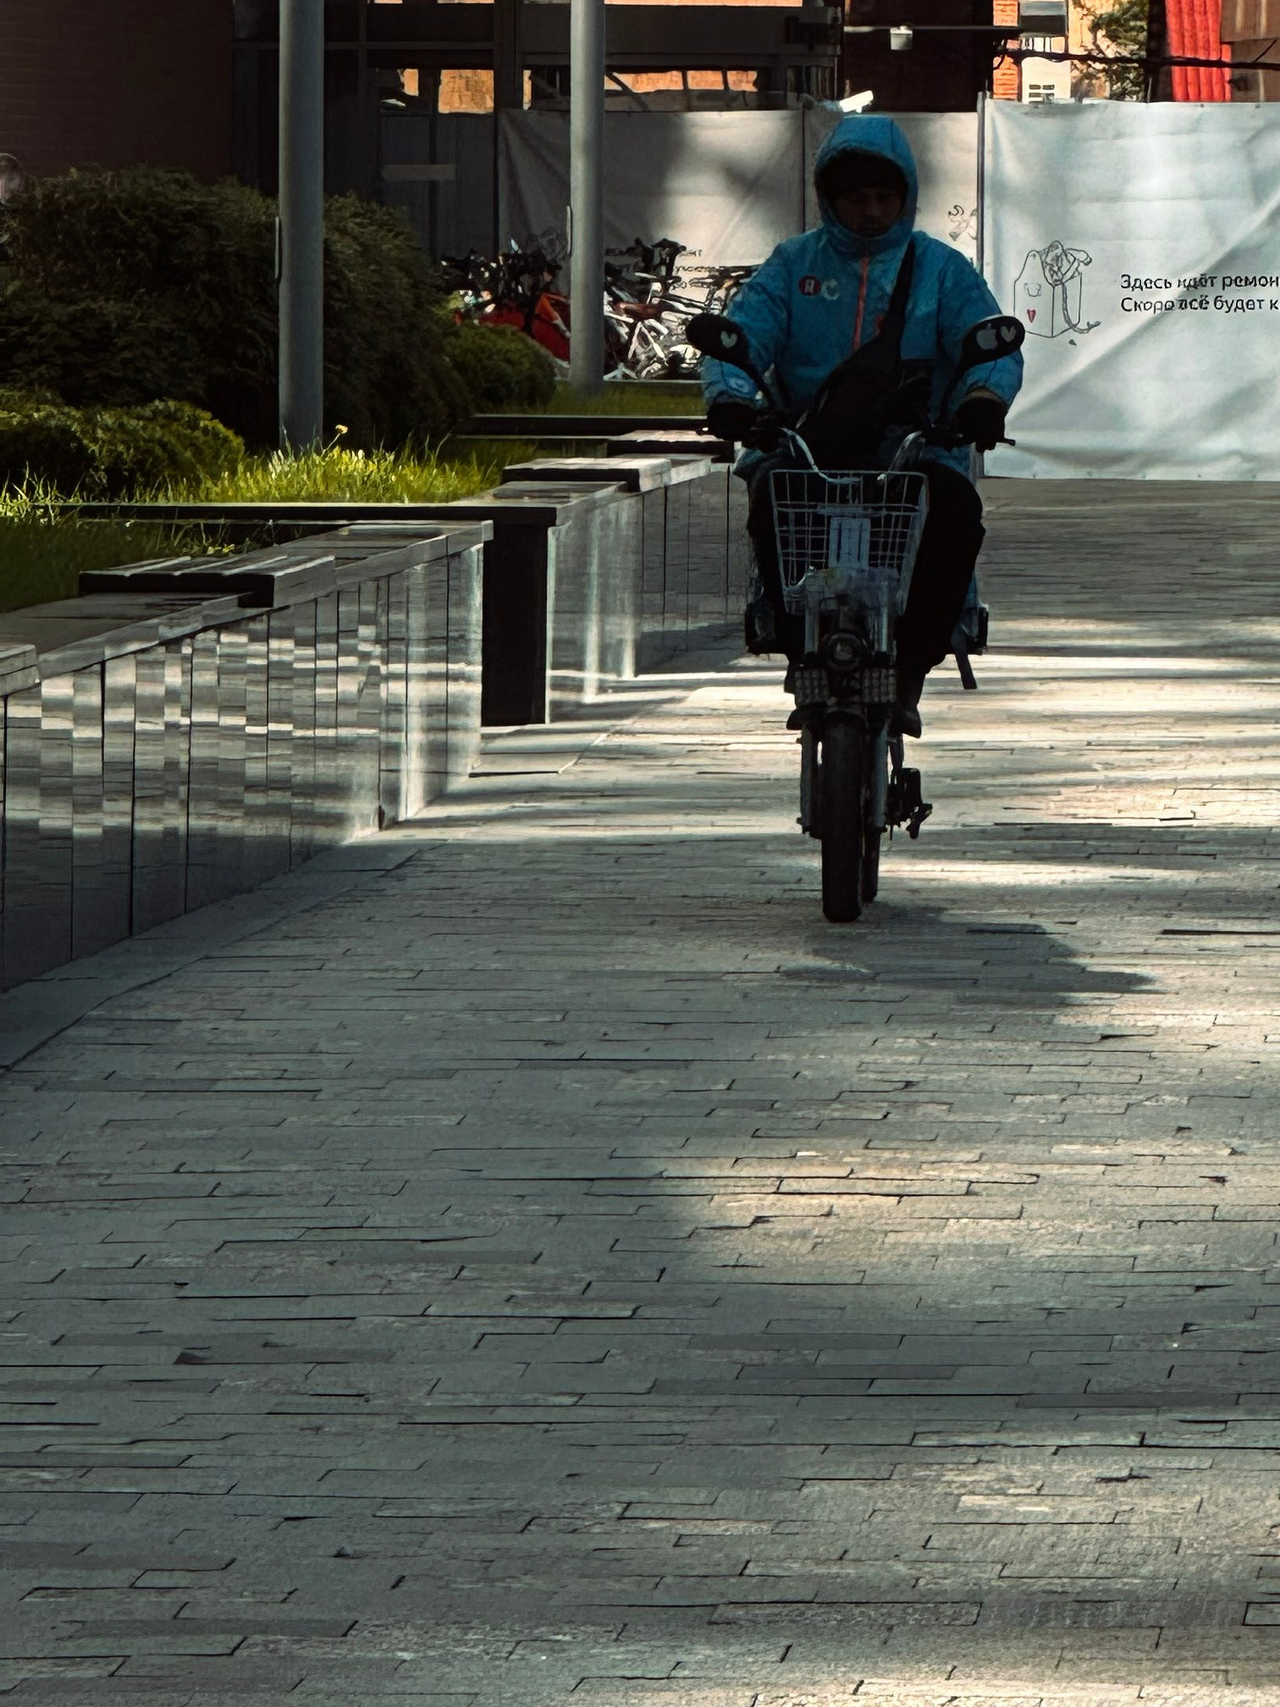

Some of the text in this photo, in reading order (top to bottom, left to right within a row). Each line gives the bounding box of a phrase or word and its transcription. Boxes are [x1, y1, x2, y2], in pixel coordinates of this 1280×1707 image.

[1120, 274, 1172, 292] Здесь
[1177, 273, 1218, 291] идёт
[1120, 297, 1175, 314] Скоро
[1177, 294, 1210, 310] всё
[1213, 295, 1265, 313] будет
